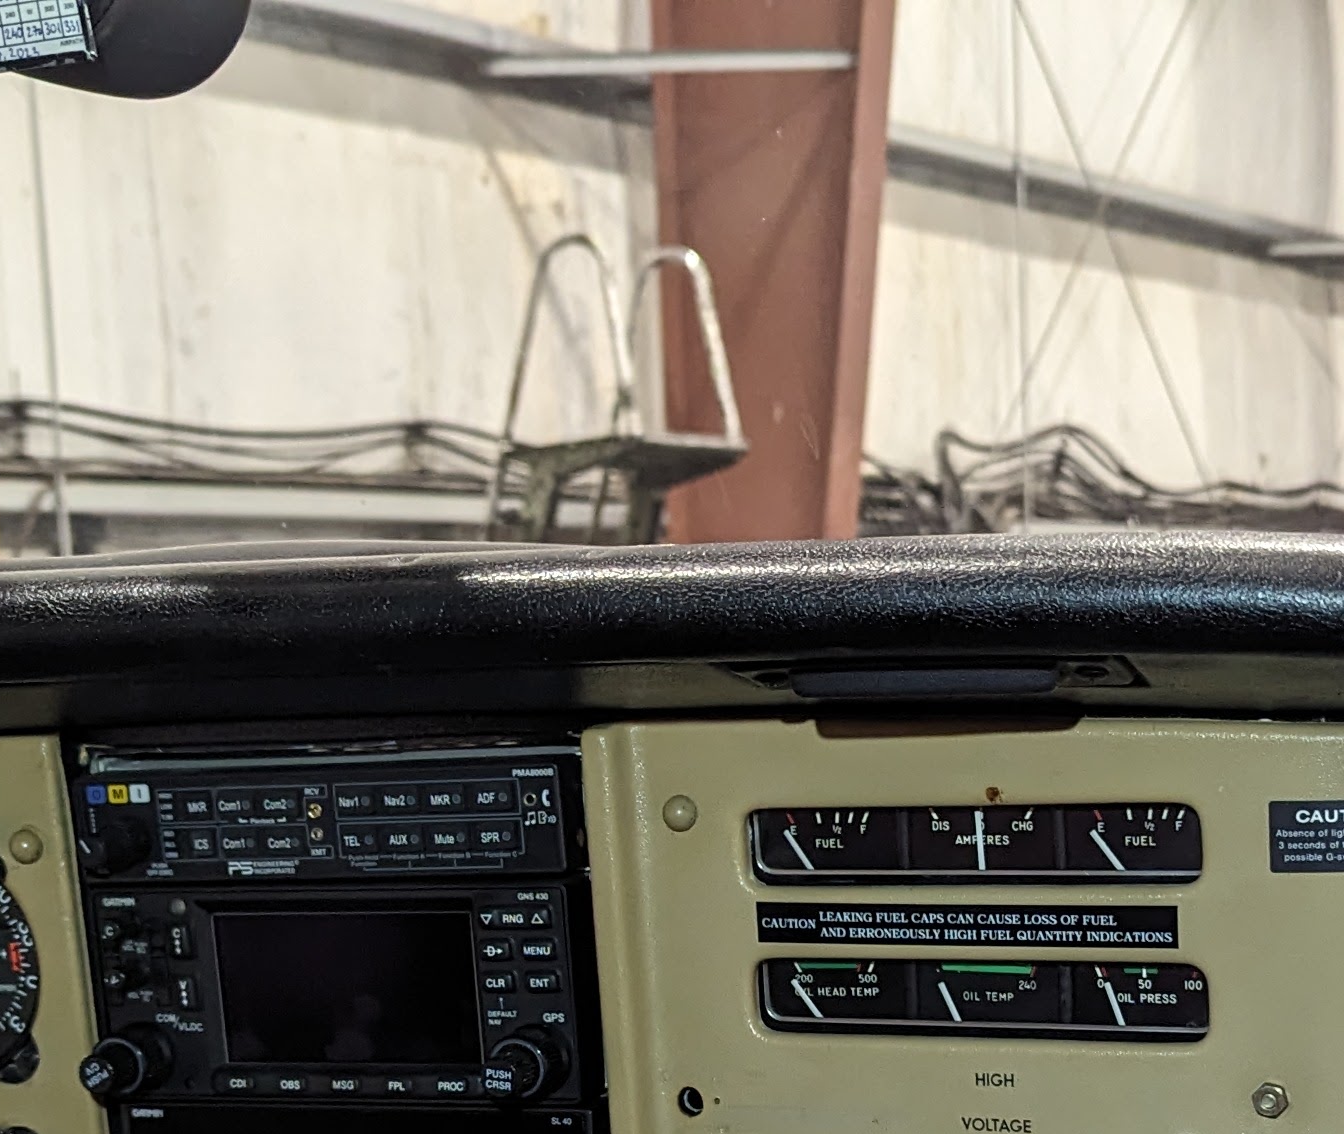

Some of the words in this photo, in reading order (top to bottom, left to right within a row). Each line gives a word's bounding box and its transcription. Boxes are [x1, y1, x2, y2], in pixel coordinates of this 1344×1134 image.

[477, 792, 495, 803] ADF
[218, 801, 241, 811] Com1
[481, 832, 499, 843] SPR
[1276, 829, 1316, 837] Absence
[1318, 828, 1329, 836] of
[223, 839, 245, 849] Com1
[390, 834, 408, 844] AUX
[815, 838, 844, 849] FUEL
[1125, 835, 1156, 846] FUEL
[1279, 841, 1285, 849] 3
[1287, 841, 1326, 849] seconds
[1330, 840, 1340, 848] of
[1284, 853, 1322, 863] possible
[503, 915, 524, 923] RNG
[761, 918, 816, 930] CAUTION
[819, 912, 873, 923] LEAKING
[876, 912, 909, 924] FUEL
[911, 913, 944, 924] CAPS
[947, 913, 974, 924] CAN
[977, 913, 1021, 925] CAUSE
[1023, 915, 1057, 926] LOSS
[1060, 915, 1079, 926] OF
[1082, 915, 1117, 927] FUEL
[820, 927, 847, 939] AND
[849, 927, 940, 940] ERRONEOUSLY
[943, 929, 977, 940] HIGH
[980, 930, 1014, 941] FUEL
[1016, 930, 1084, 943] QUANTITY
[1086, 931, 1173, 943] INDICATIONS
[524, 947, 550, 955] MENU
[486, 979, 505, 987] CLR
[530, 979, 549, 987] ENT
[859, 974, 878, 984] 500
[1138, 979, 1152, 989] 50
[1184, 980, 1203, 990] 100
[817, 987, 848, 997] HEAD
[850, 987, 880, 997] TEMP
[962, 991, 982, 1002] OIL
[984, 992, 1014, 1002] TEMP
[1117, 993, 1136, 1003] OIL
[1139, 994, 1177, 1004] PRESS
[543, 1013, 565, 1022] GPS
[486, 1069, 511, 1079] PUSH
[230, 1079, 246, 1087] CDI
[281, 1080, 300, 1089] OBS
[975, 1073, 1015, 1087] HIGH
[333, 1081, 354, 1090] MSG
[388, 1082, 405, 1091] FPL
[438, 1082, 463, 1091] PROC
[485, 1080, 511, 1091] CRSR
[551, 1117, 561, 1125] SL
[961, 1117, 1032, 1133] VOLTAGE
